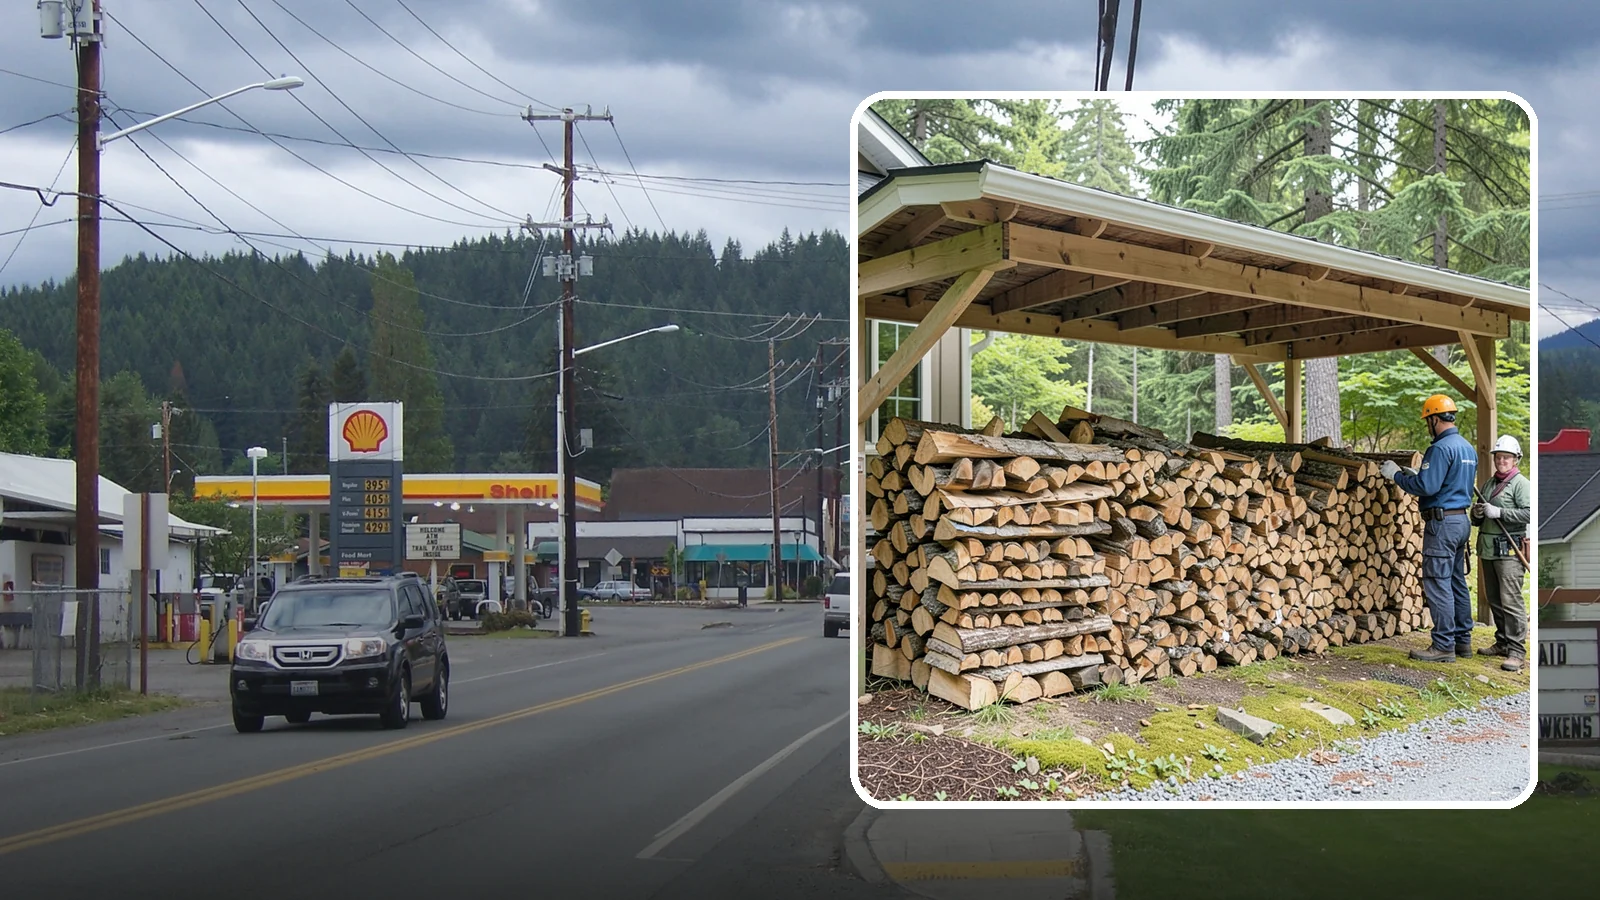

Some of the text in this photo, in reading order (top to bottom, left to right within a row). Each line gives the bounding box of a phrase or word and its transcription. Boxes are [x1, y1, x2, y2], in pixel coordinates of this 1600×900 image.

[366, 480, 383, 490] 395
[490, 484, 547, 499] Shell
[366, 494, 383, 504] 405
[366, 508, 383, 518] 415
[366, 522, 383, 532] 429
